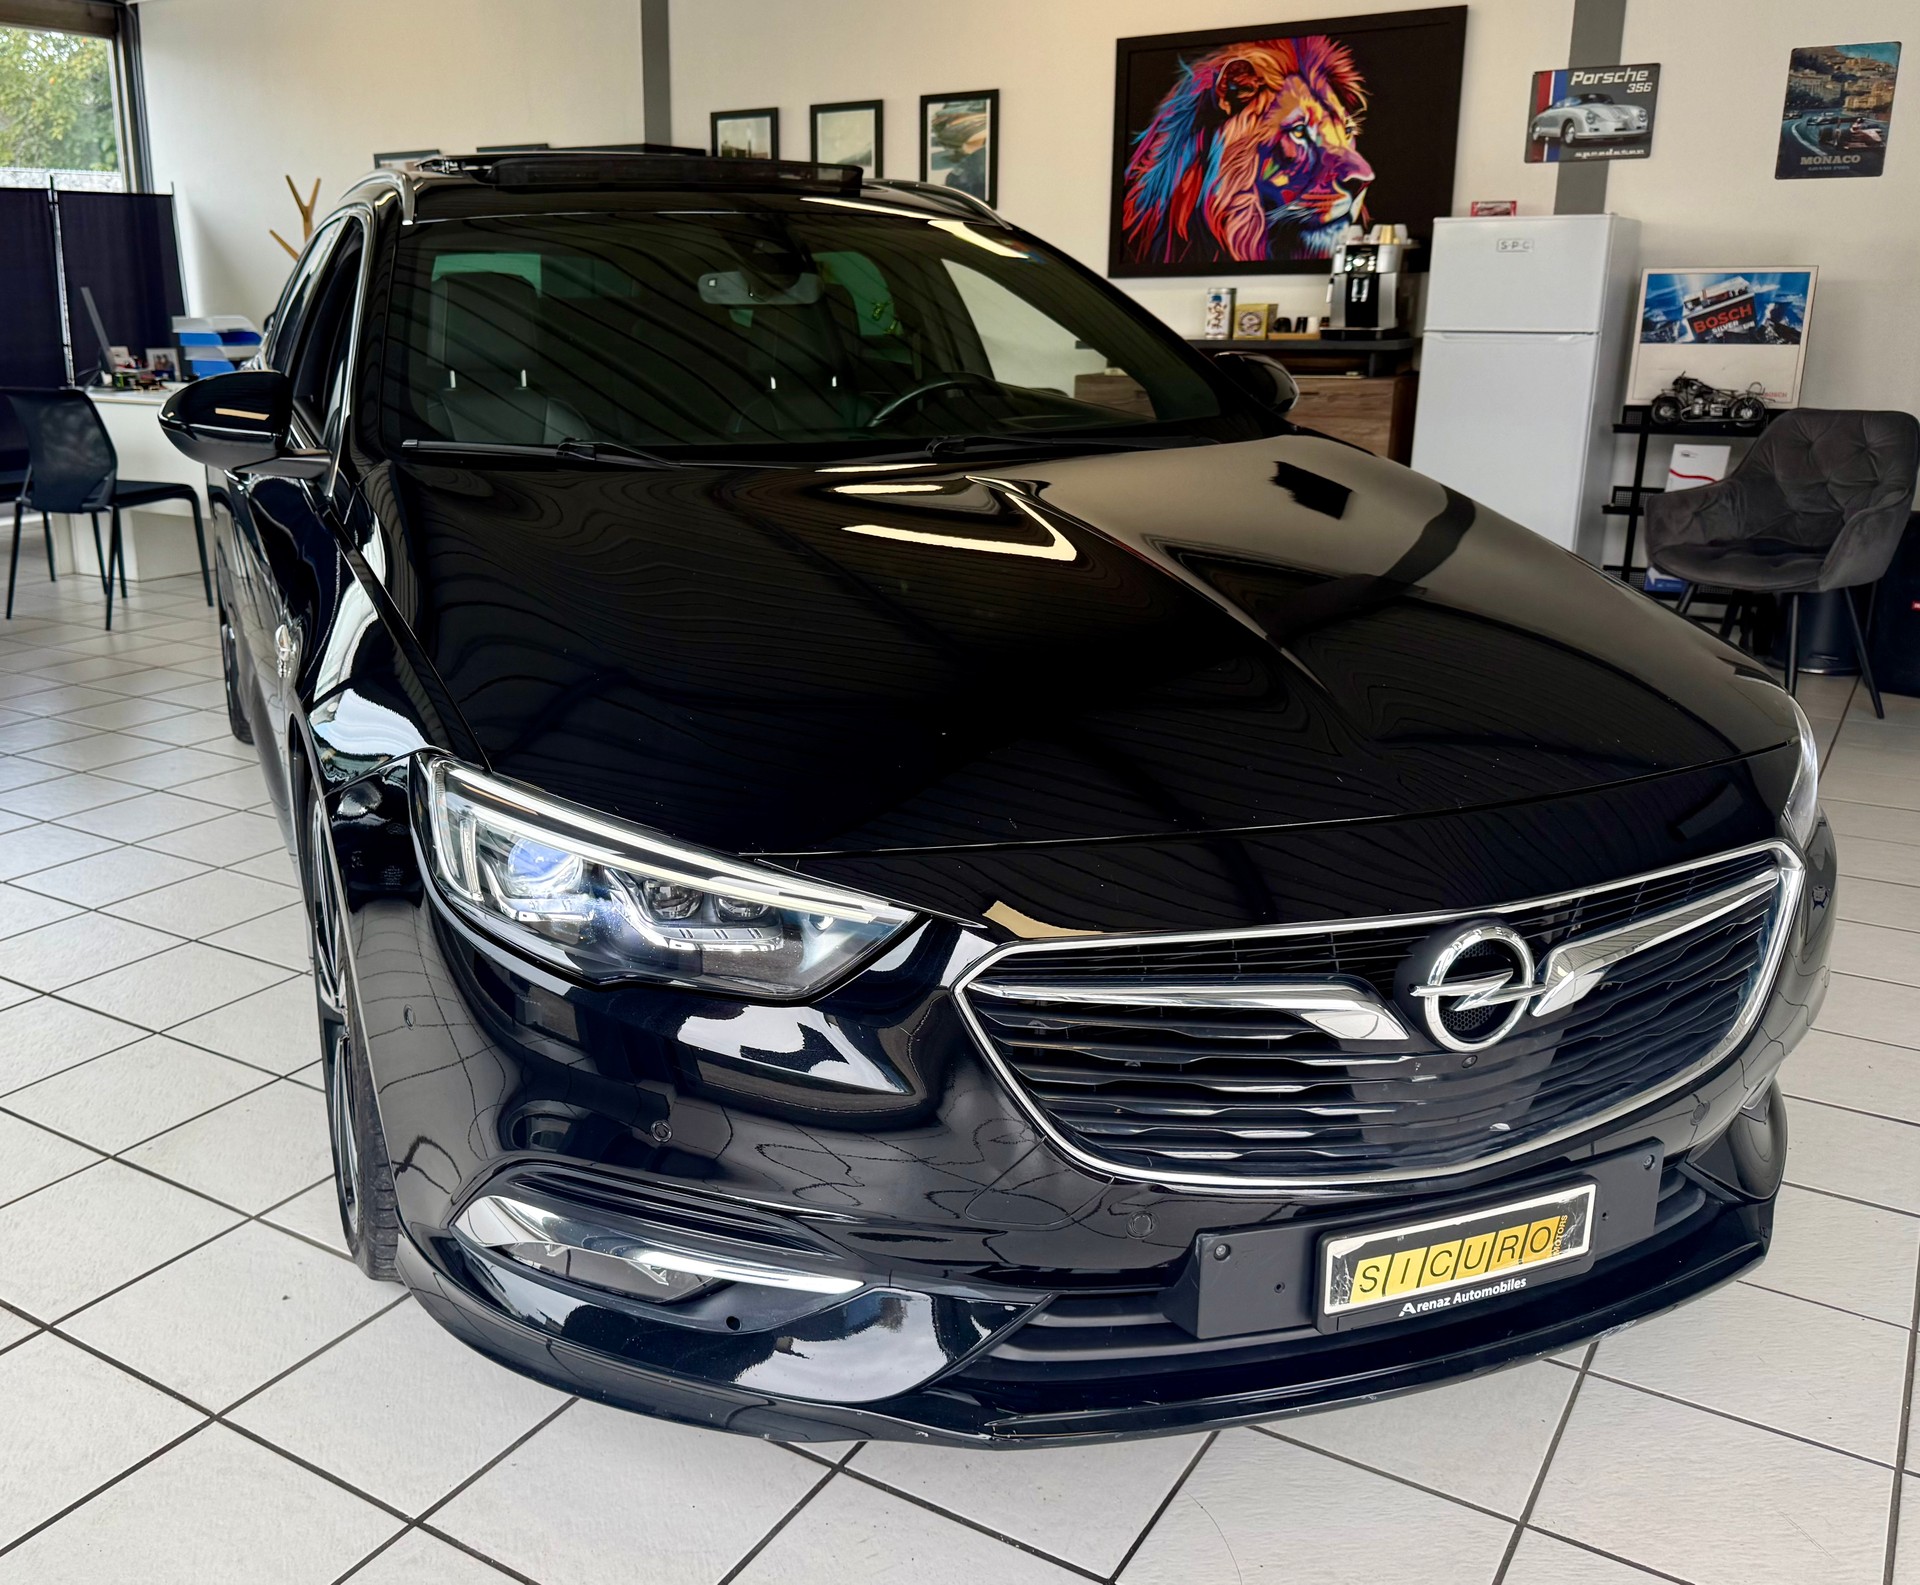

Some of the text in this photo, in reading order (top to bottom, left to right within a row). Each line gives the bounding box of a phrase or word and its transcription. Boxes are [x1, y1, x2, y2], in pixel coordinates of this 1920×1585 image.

[1570, 68, 1649, 86] Porsche
[1626, 82, 1653, 94] 356
[1800, 155, 1861, 165] MONACO
[1693, 303, 1753, 334] BOSCH
[1711, 320, 1740, 335] SILVER
[1358, 1226, 1551, 1294] SICURO
[1398, 1276, 1527, 1317] Arenaz Automobiles
